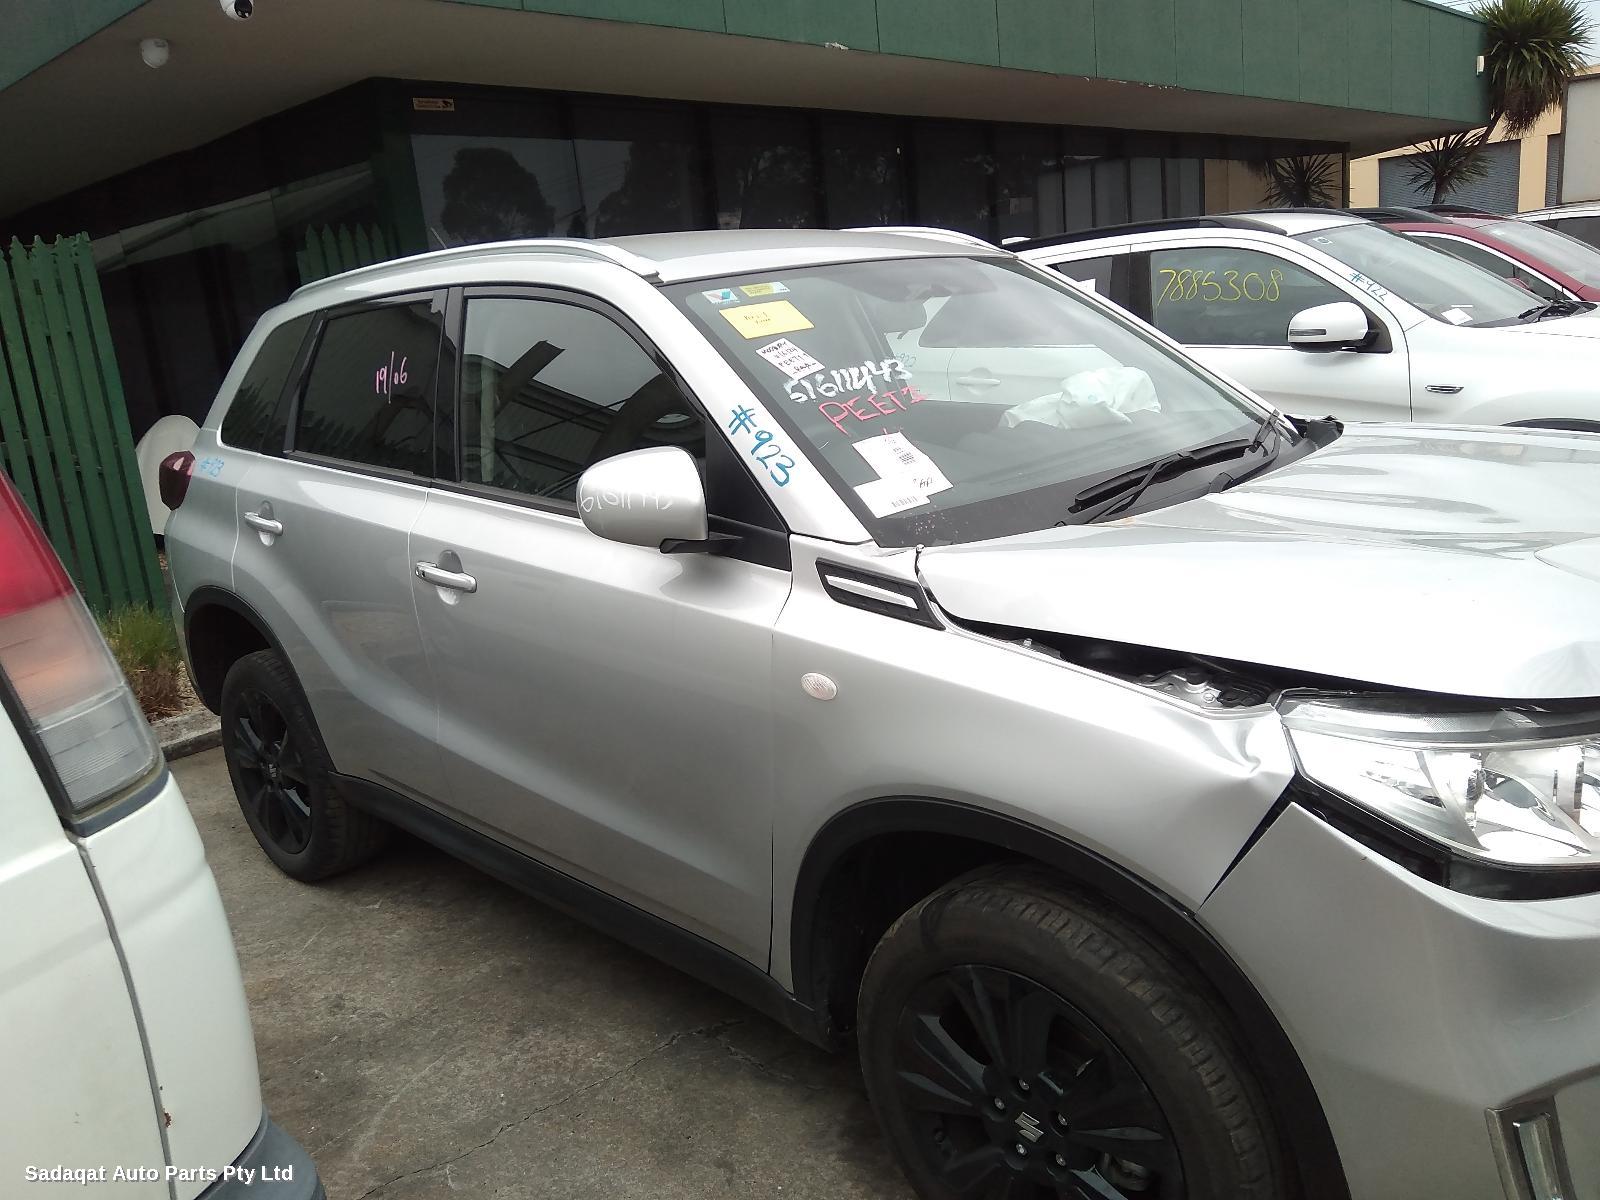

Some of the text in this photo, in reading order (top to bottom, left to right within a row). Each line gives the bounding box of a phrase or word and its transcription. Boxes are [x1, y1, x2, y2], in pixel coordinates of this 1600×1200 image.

[1157, 268, 1284, 307] 7885308
[376, 350, 408, 404] 19/06
[728, 404, 796, 488] #923
